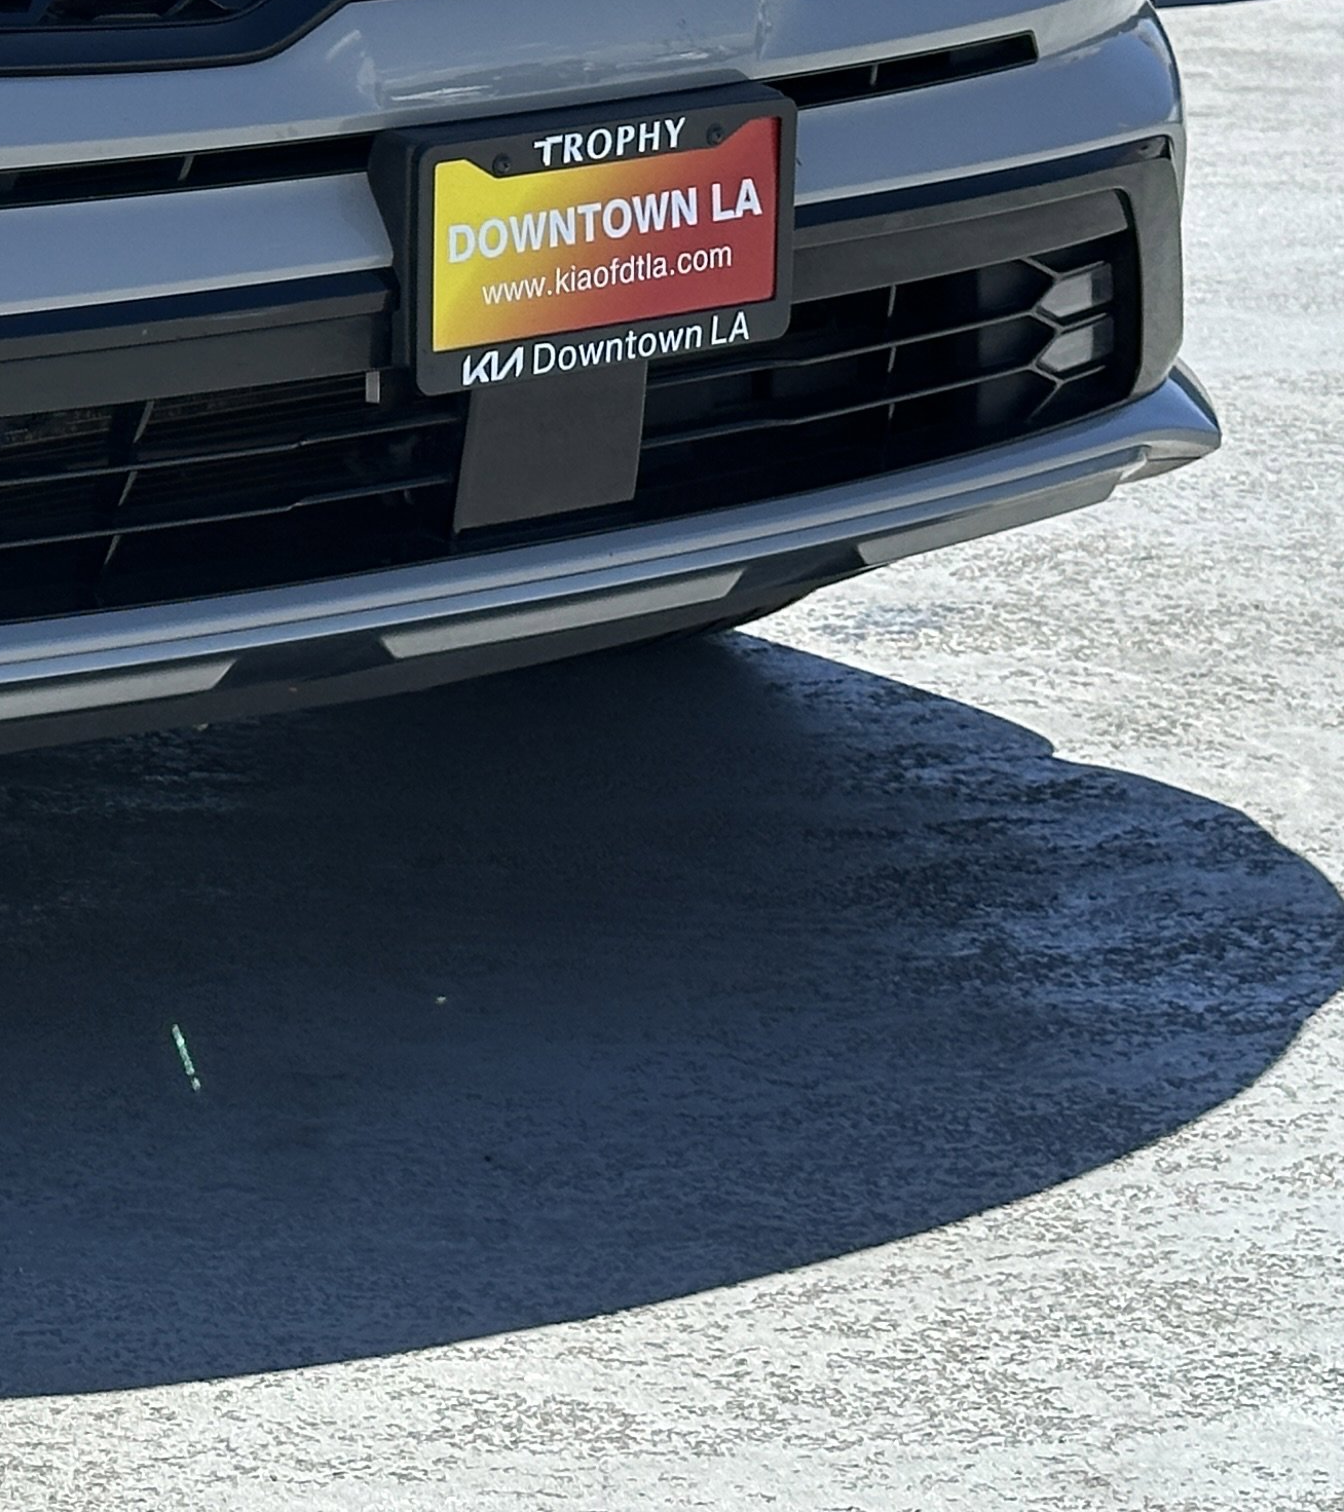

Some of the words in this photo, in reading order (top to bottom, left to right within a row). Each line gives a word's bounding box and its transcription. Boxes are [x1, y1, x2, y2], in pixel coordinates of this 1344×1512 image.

[533, 116, 687, 167] TROPHY
[447, 186, 699, 264] DOWNTOWN
[711, 178, 764, 223] LA
[481, 242, 733, 306] www.kiaofdtla.com
[462, 345, 524, 387] KIA
[532, 322, 703, 376] Downtown
[710, 311, 750, 347] LA
